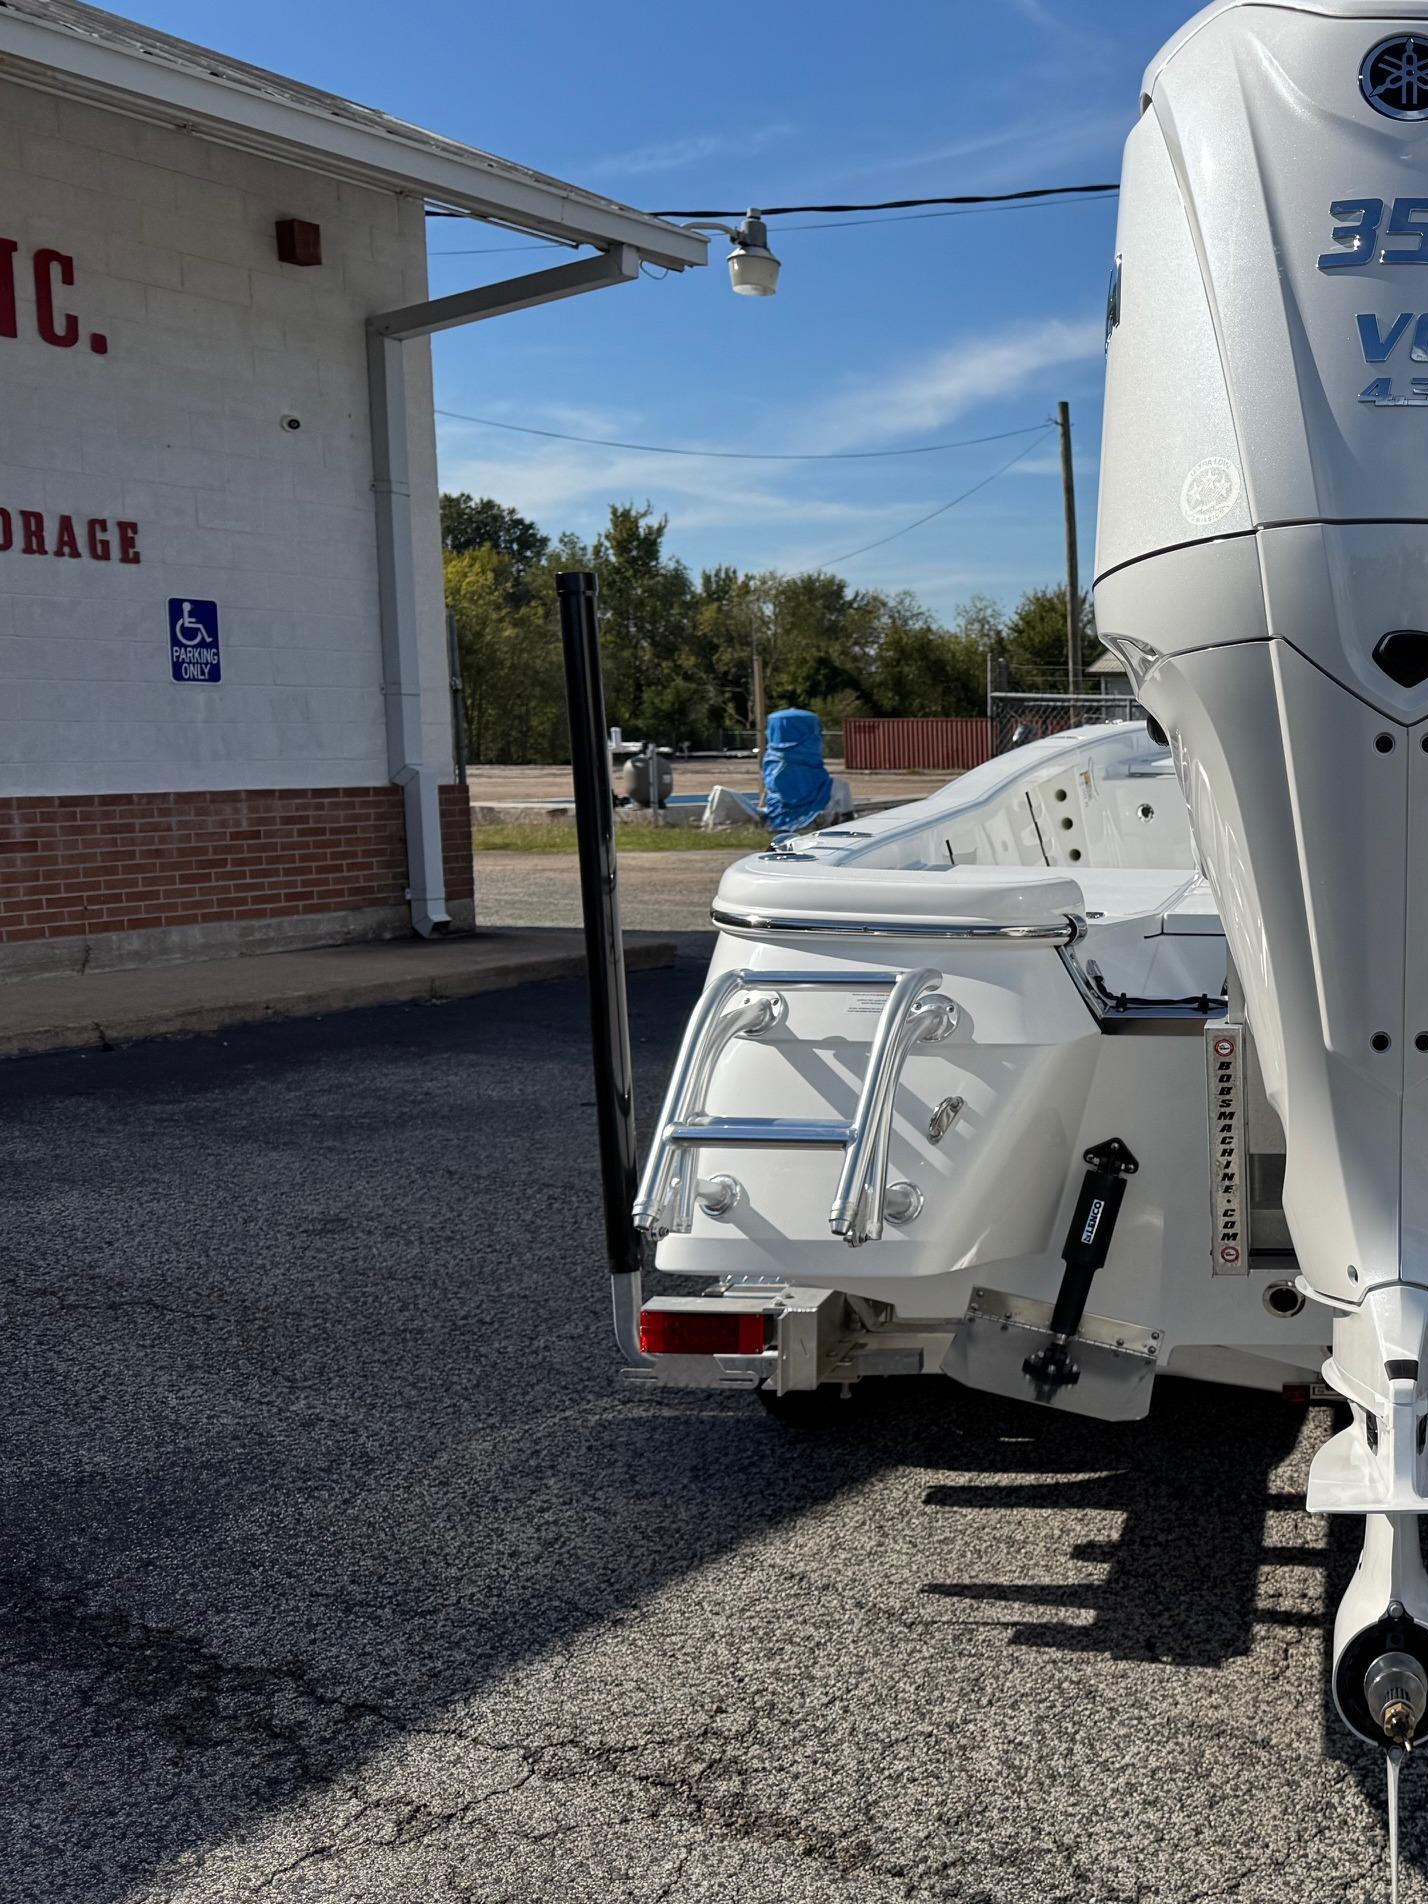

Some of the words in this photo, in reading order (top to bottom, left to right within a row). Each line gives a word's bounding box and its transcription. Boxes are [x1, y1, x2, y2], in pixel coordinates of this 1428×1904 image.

[173, 646, 219, 664] PARKING
[182, 662, 210, 679] ONLY
[1084, 1200, 1103, 1236] LENCO
